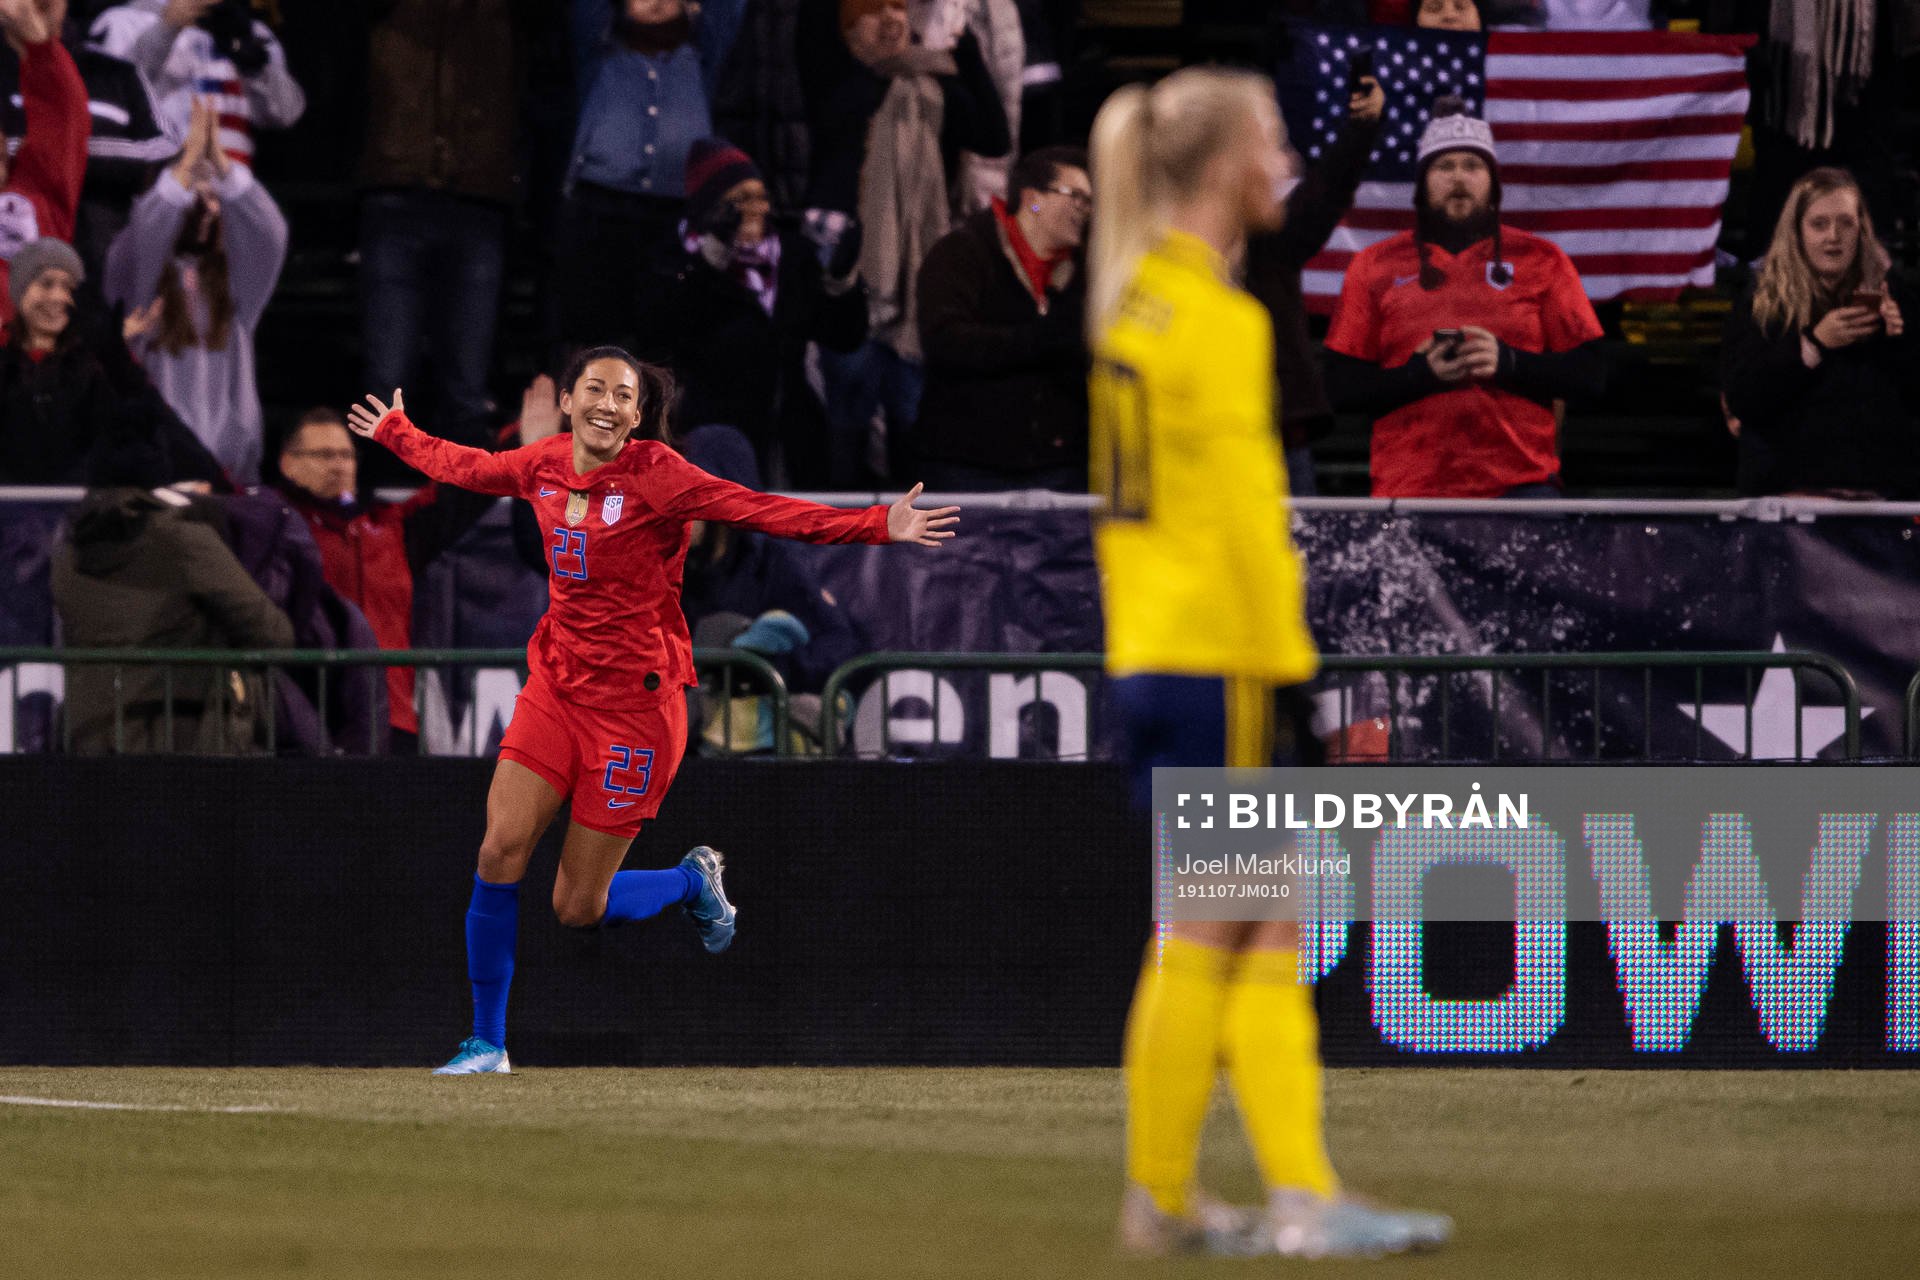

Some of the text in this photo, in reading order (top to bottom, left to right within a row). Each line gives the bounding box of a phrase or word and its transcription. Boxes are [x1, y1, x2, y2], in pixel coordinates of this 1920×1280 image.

[552, 527, 588, 580] 23
[603, 745, 655, 795] 23
[1156, 812, 1920, 1052] OW
